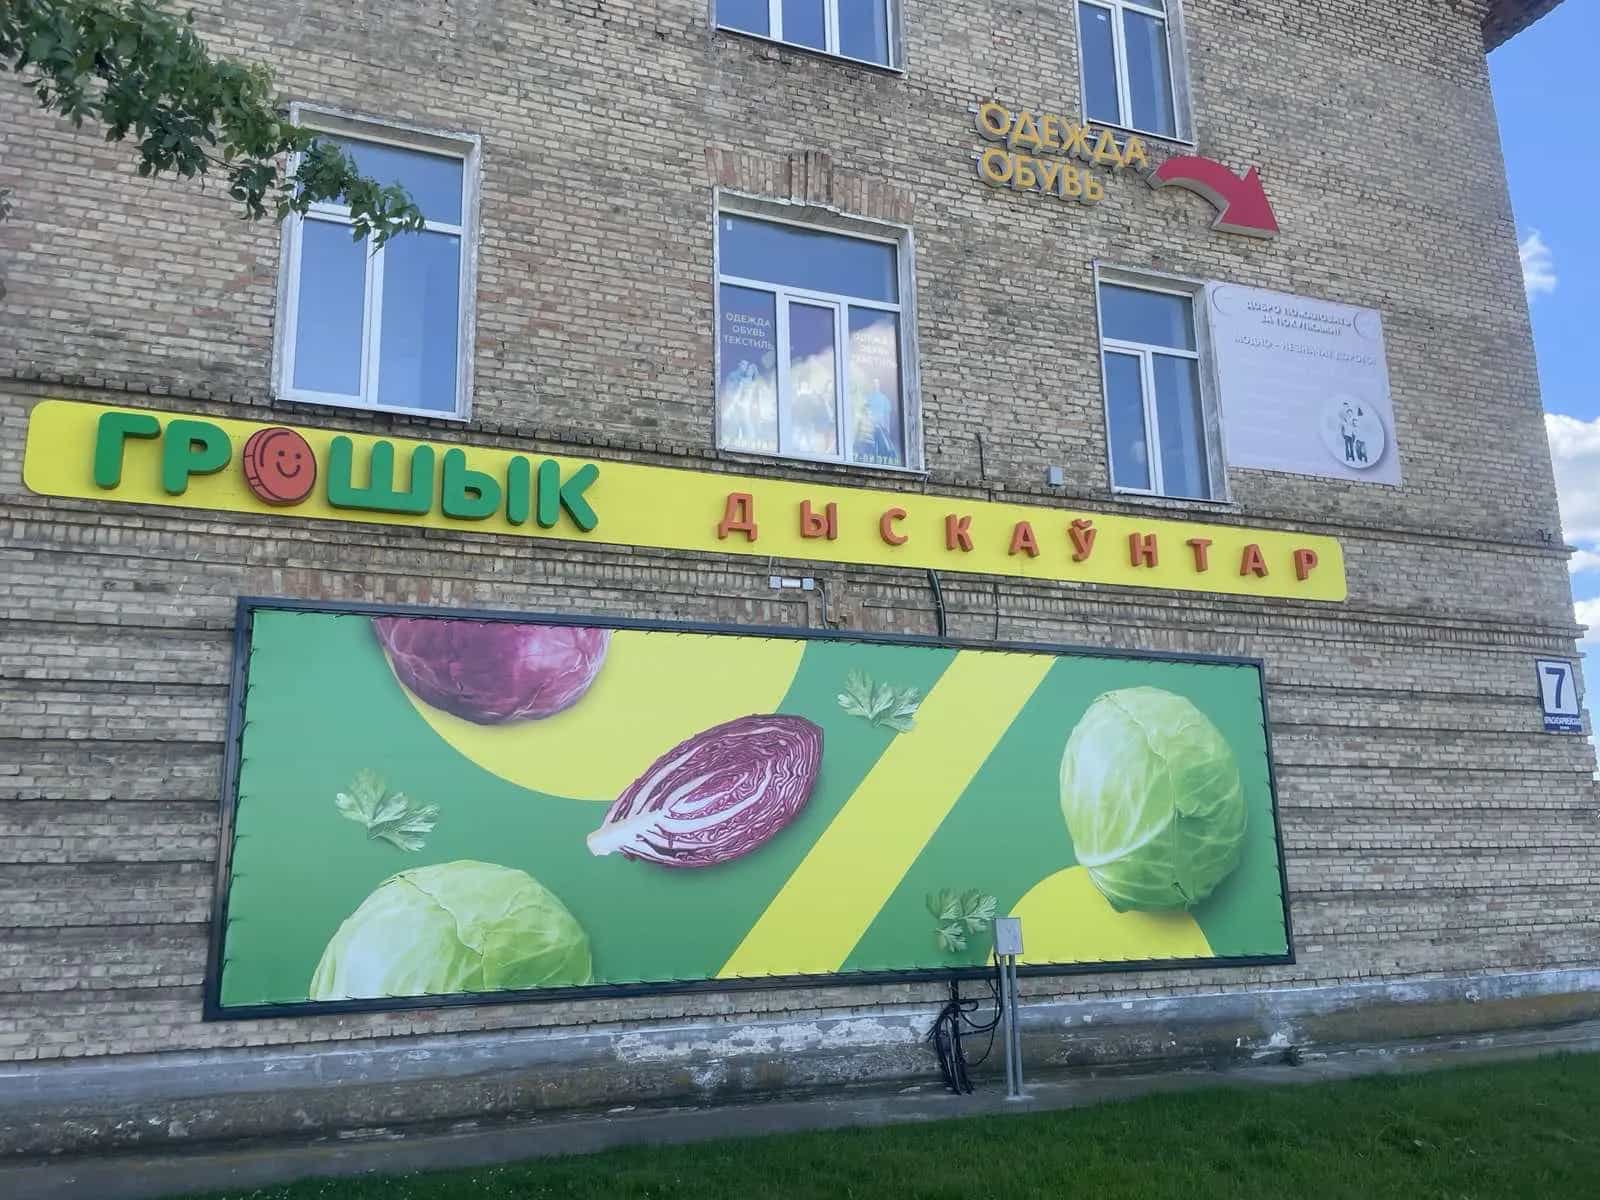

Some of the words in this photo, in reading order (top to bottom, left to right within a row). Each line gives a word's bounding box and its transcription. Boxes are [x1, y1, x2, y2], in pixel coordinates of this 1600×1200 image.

[976, 103, 1149, 170] ОДЕЖДА
[977, 148, 1105, 204] ОБУВЬ
[726, 312, 771, 328] ОДЕЖДА
[732, 324, 766, 337] ОБУВЬ
[94, 411, 600, 533] ГРОШЫК
[718, 492, 1318, 581] ДЫСКАЎНТАР
[1545, 667, 1565, 708] 7
